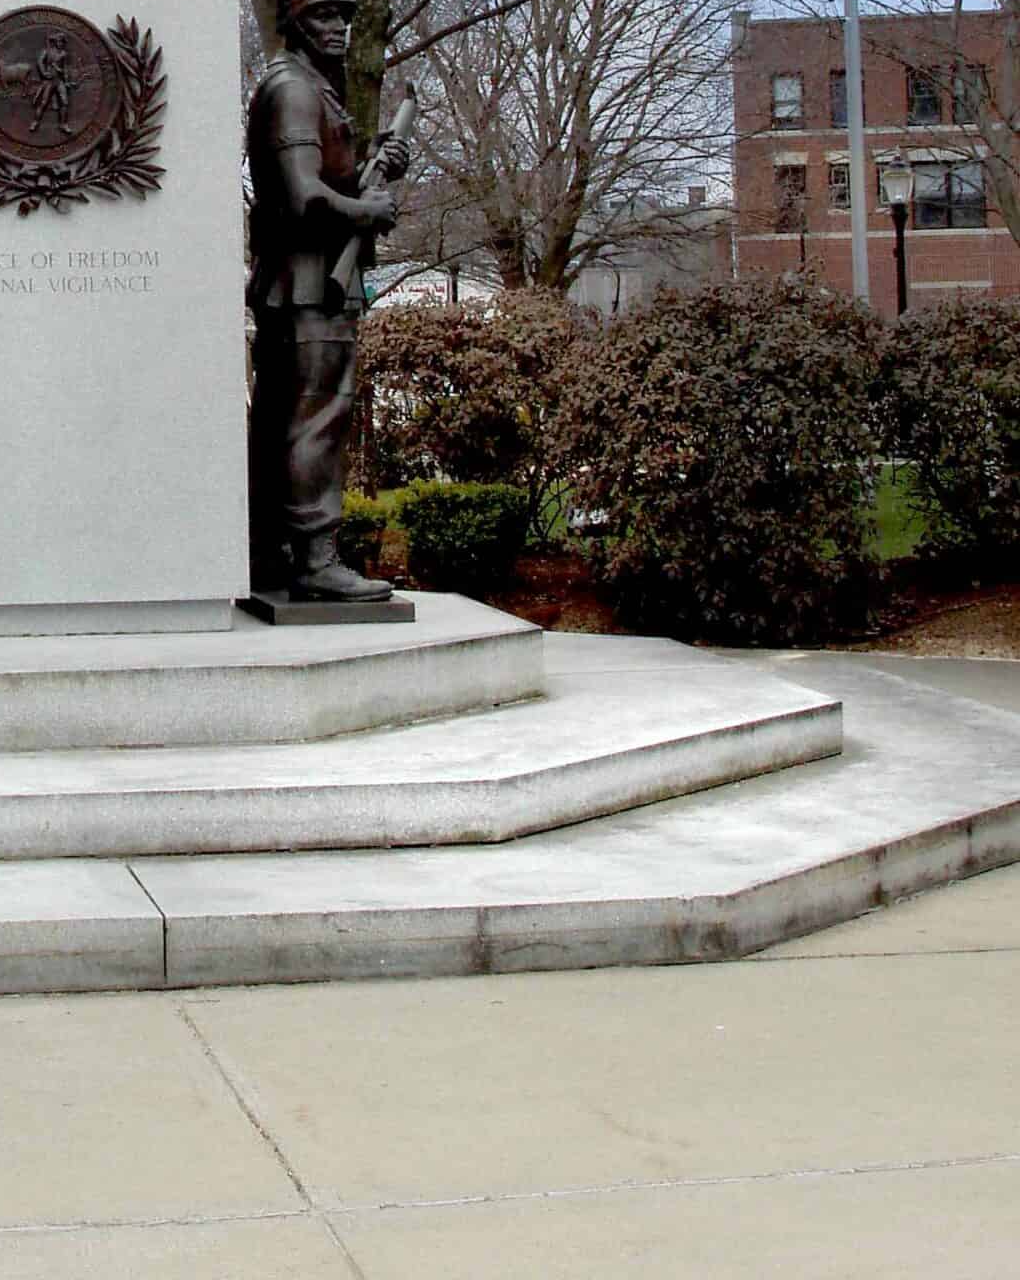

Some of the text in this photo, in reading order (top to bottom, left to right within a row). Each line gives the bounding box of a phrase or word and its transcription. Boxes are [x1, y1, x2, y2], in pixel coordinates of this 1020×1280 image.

[31, 251, 61, 269] OF
[68, 250, 160, 268] FREEDOM
[47, 275, 154, 294] VIGILANCE
